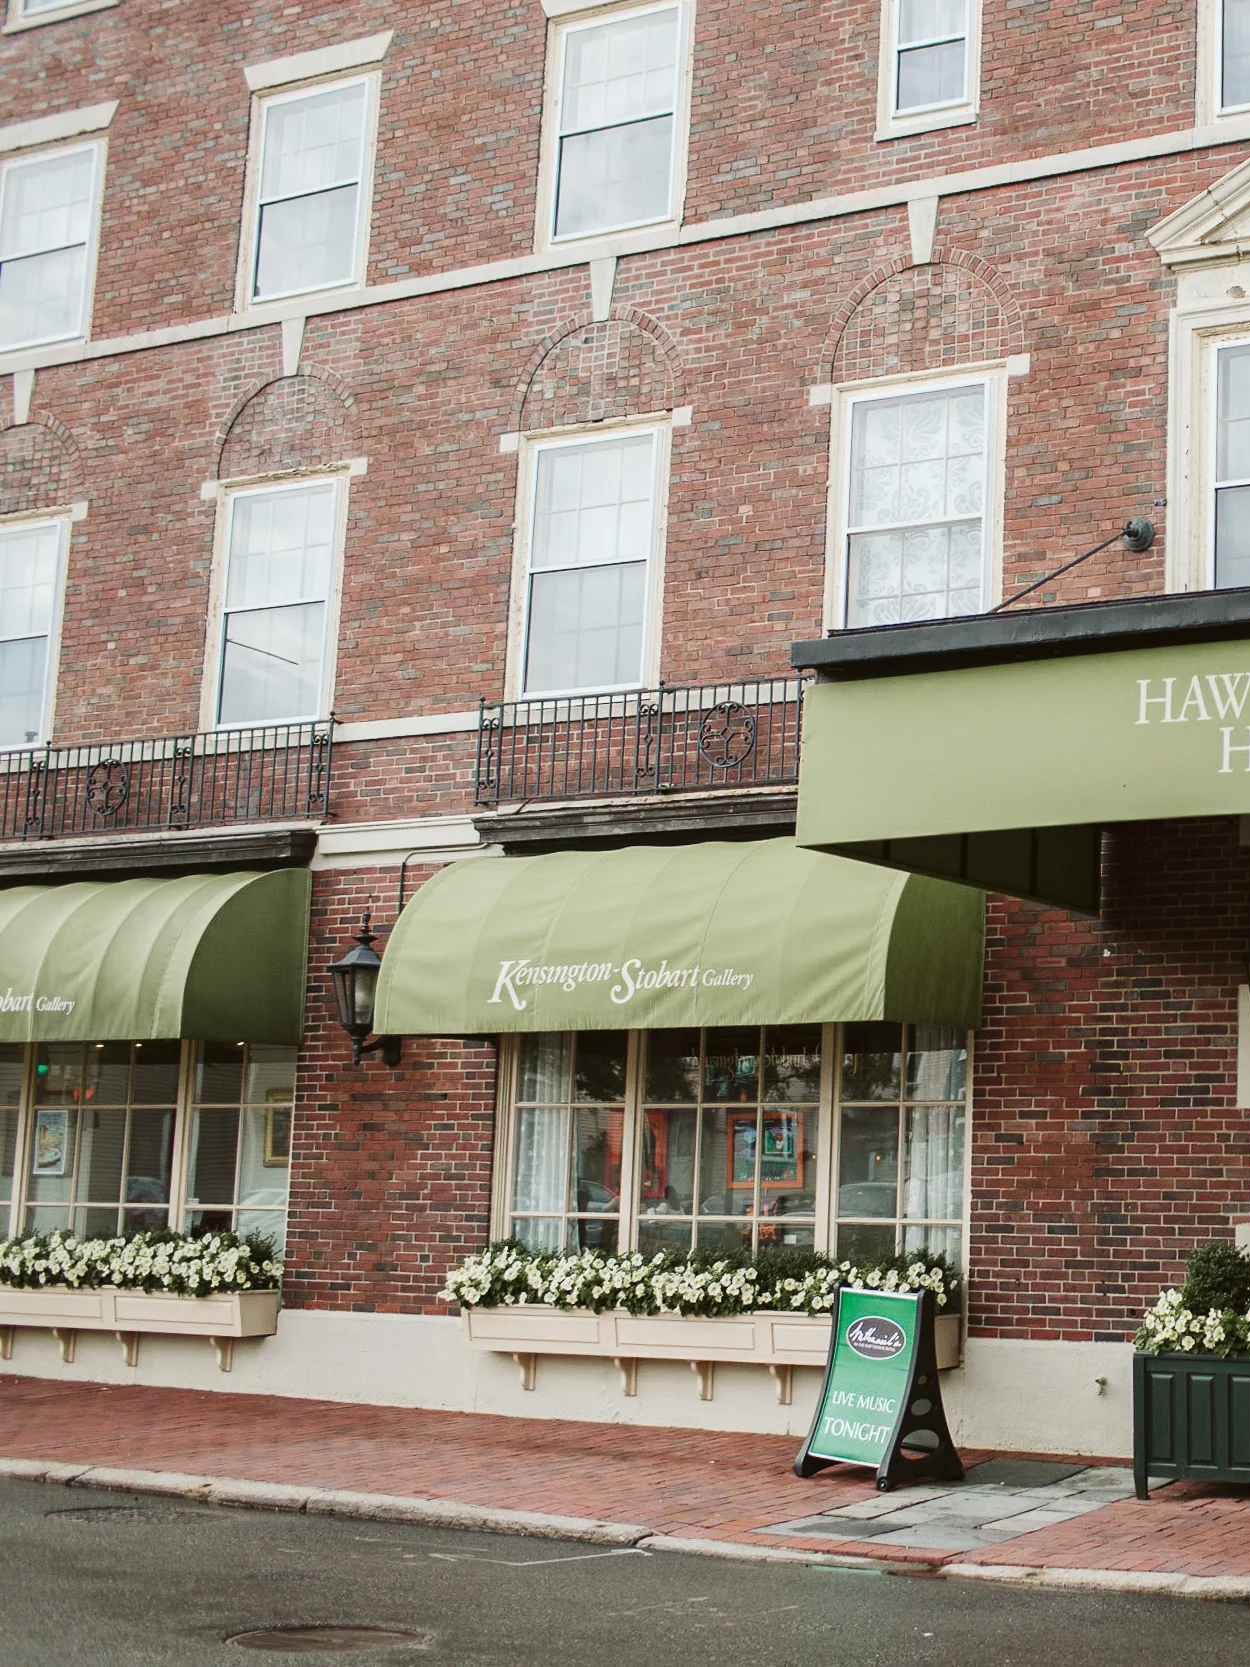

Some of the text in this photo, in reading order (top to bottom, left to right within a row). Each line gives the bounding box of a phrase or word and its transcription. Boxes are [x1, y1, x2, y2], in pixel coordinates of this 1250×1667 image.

[702, 969, 754, 990] Gallery
[36, 996, 75, 1016] Gallery
[832, 1390, 896, 1413] LIVE MUSIC
[824, 1417, 892, 1444] TONIGHT
